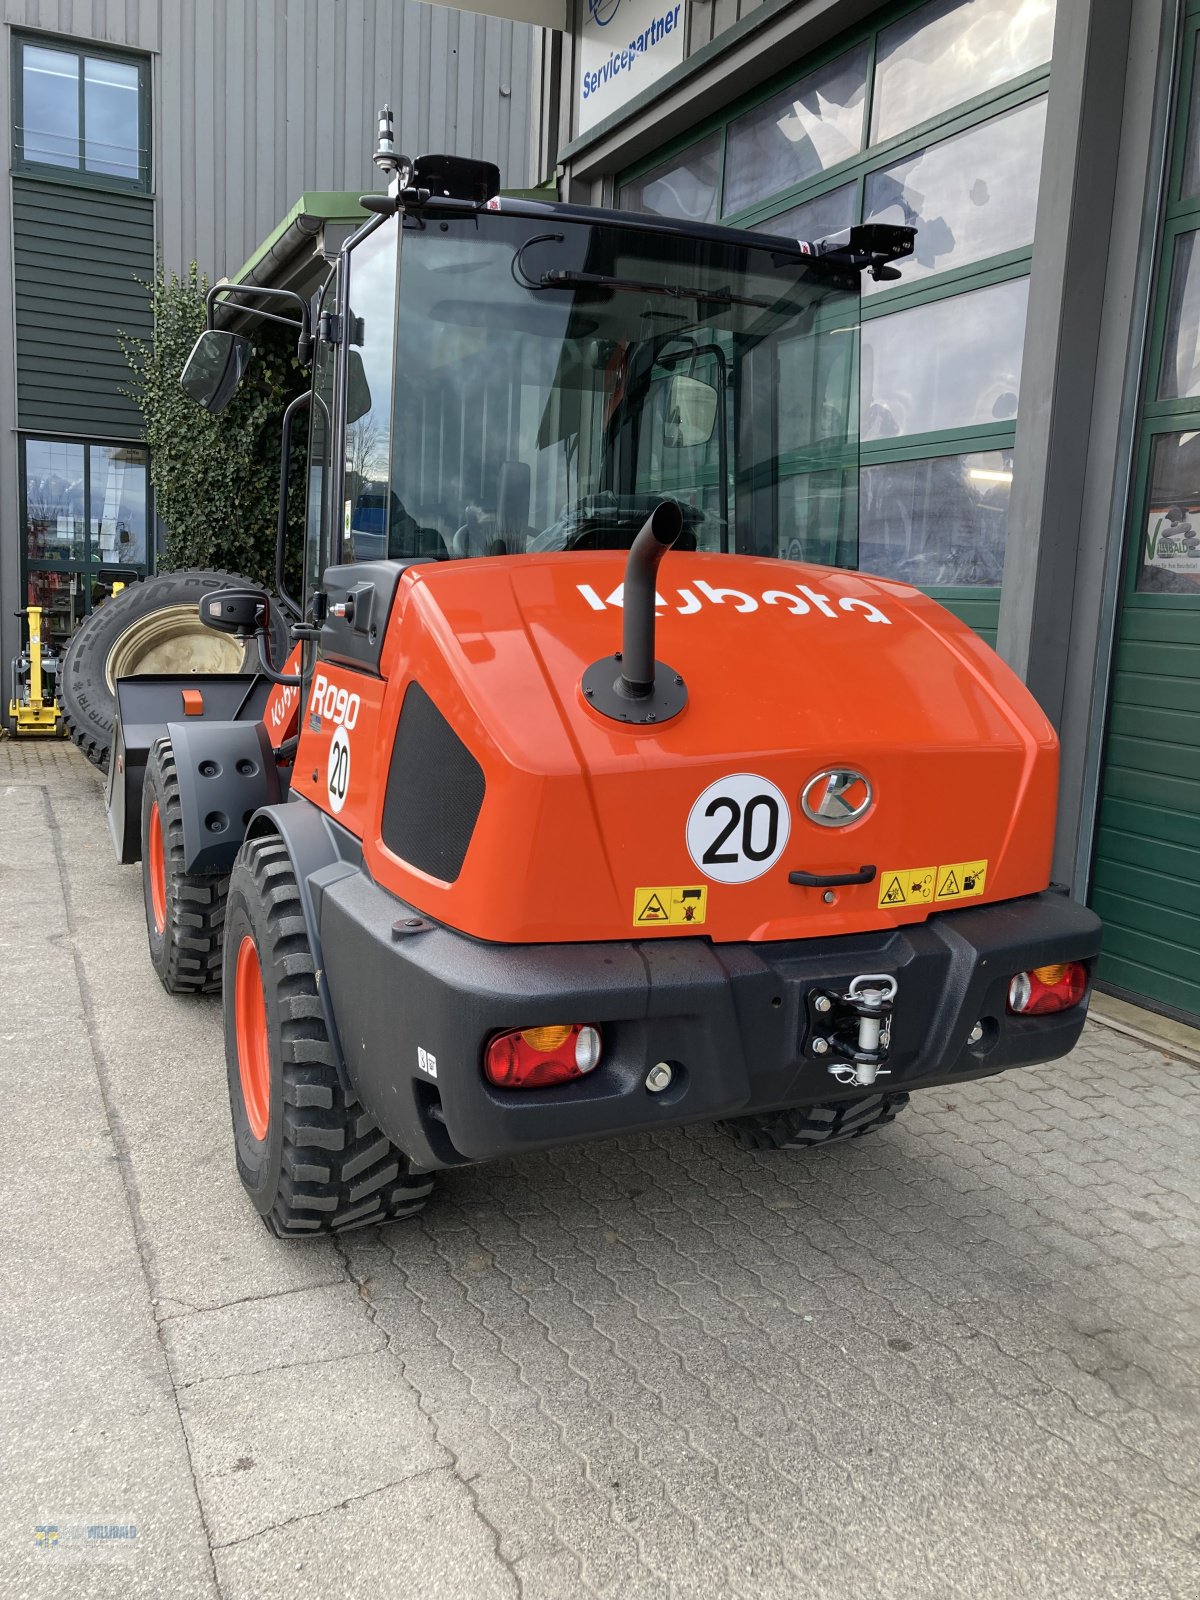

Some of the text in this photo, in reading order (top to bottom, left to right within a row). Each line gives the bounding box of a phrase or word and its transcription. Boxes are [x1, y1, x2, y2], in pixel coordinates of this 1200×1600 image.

[582, 3, 681, 99] Servicepartner
[310, 674, 361, 731] R090
[329, 740, 349, 799] 20
[702, 794, 779, 865] 20
